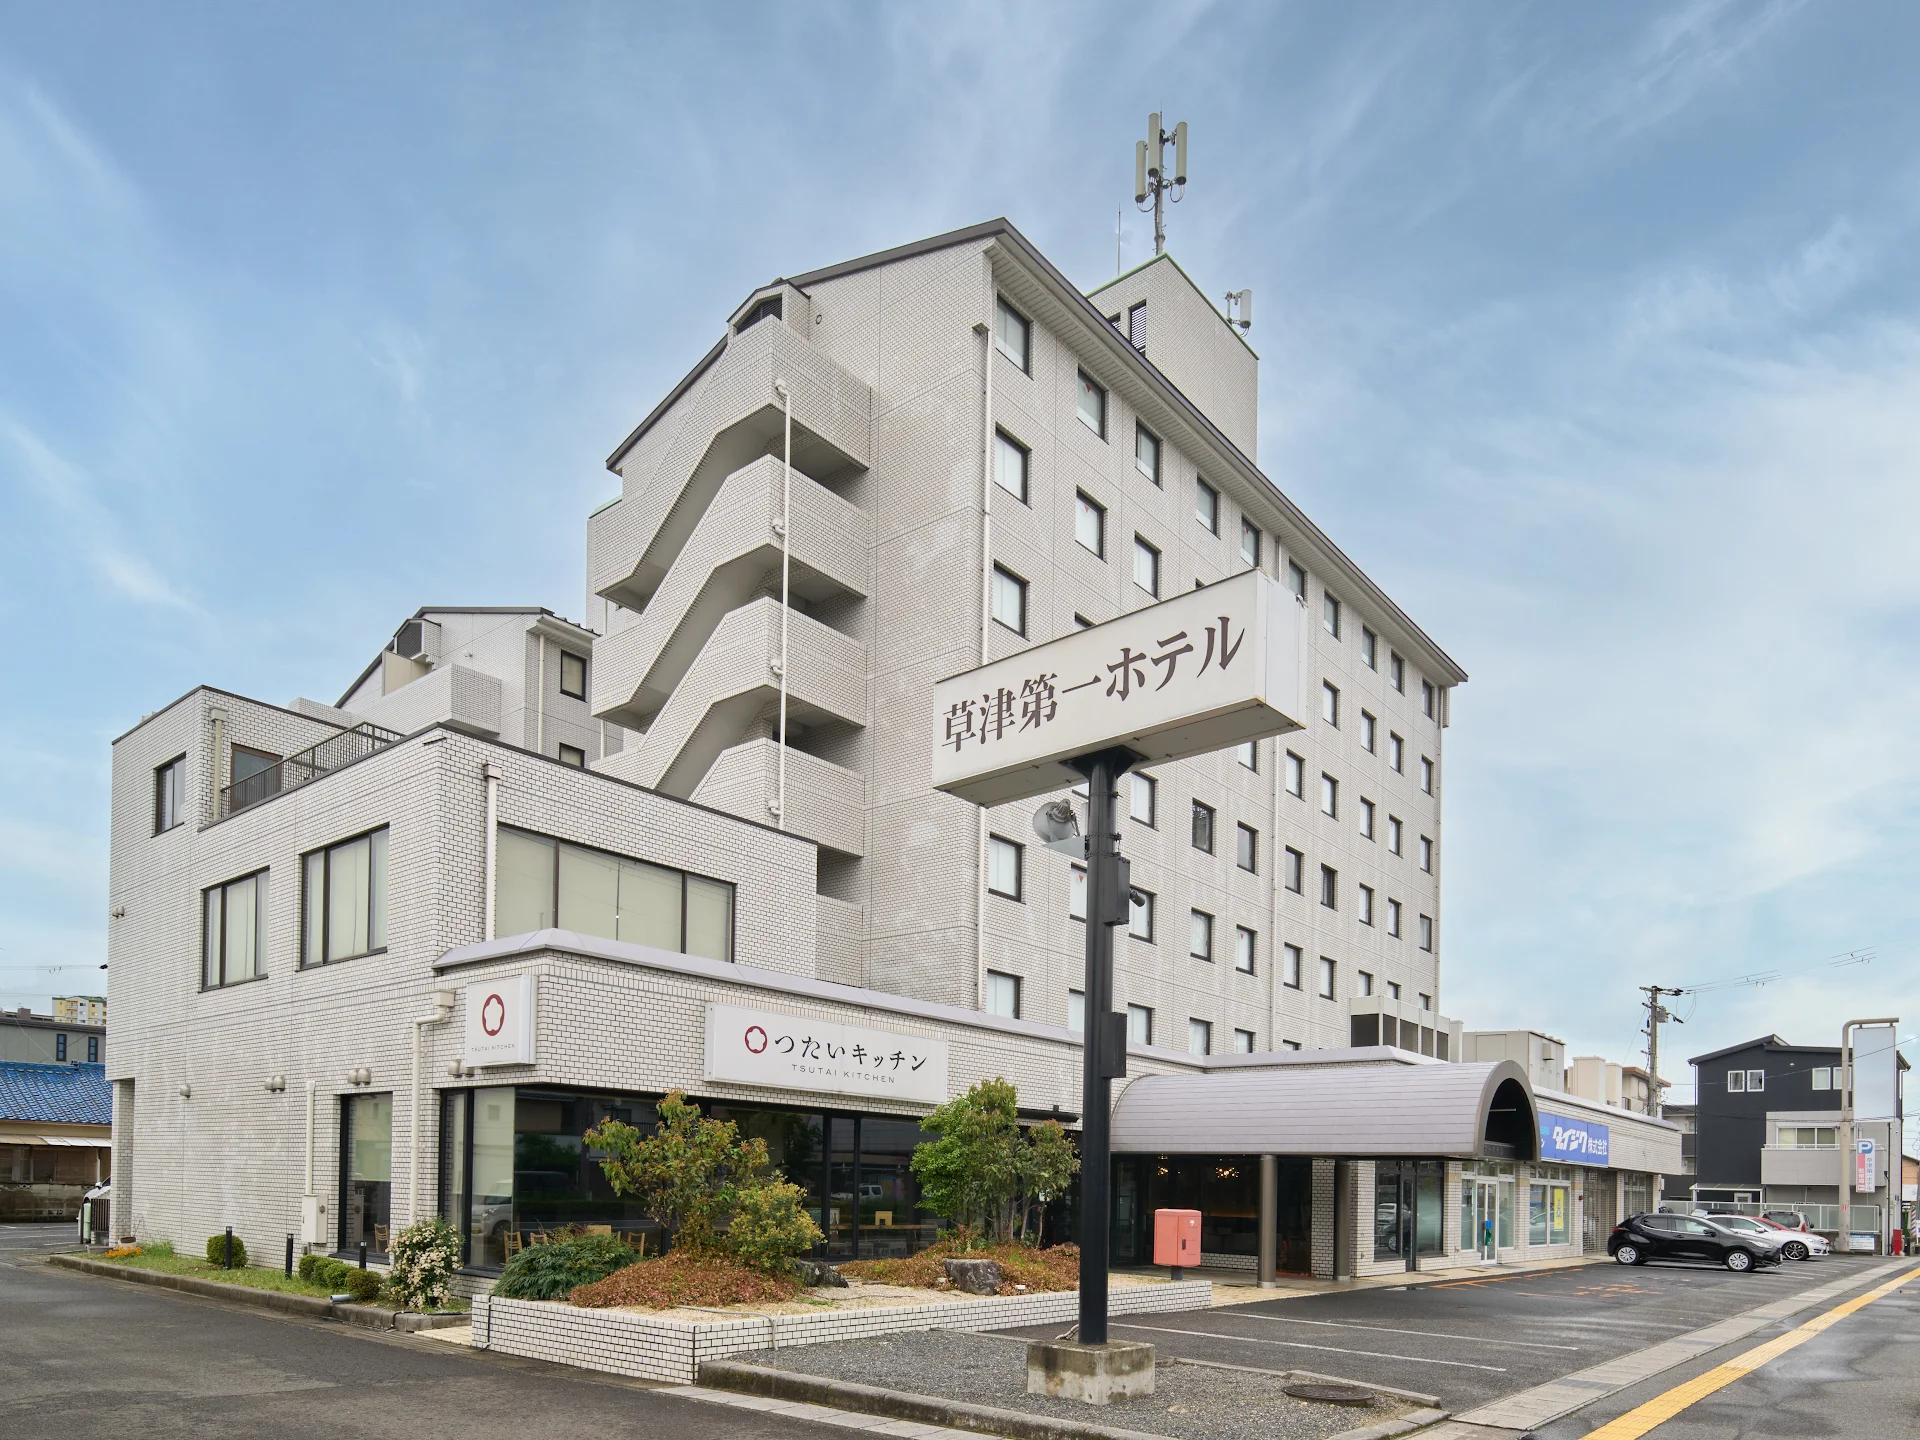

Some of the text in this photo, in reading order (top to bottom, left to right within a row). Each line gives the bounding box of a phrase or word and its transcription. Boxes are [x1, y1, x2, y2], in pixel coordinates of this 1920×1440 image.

[942, 616, 1245, 752] 草津第一ホテル
[774, 1035, 928, 1072] つたいキッチン
[791, 1063, 896, 1084] TSUTAI KITCHEN
[1858, 1140, 1873, 1154] P
